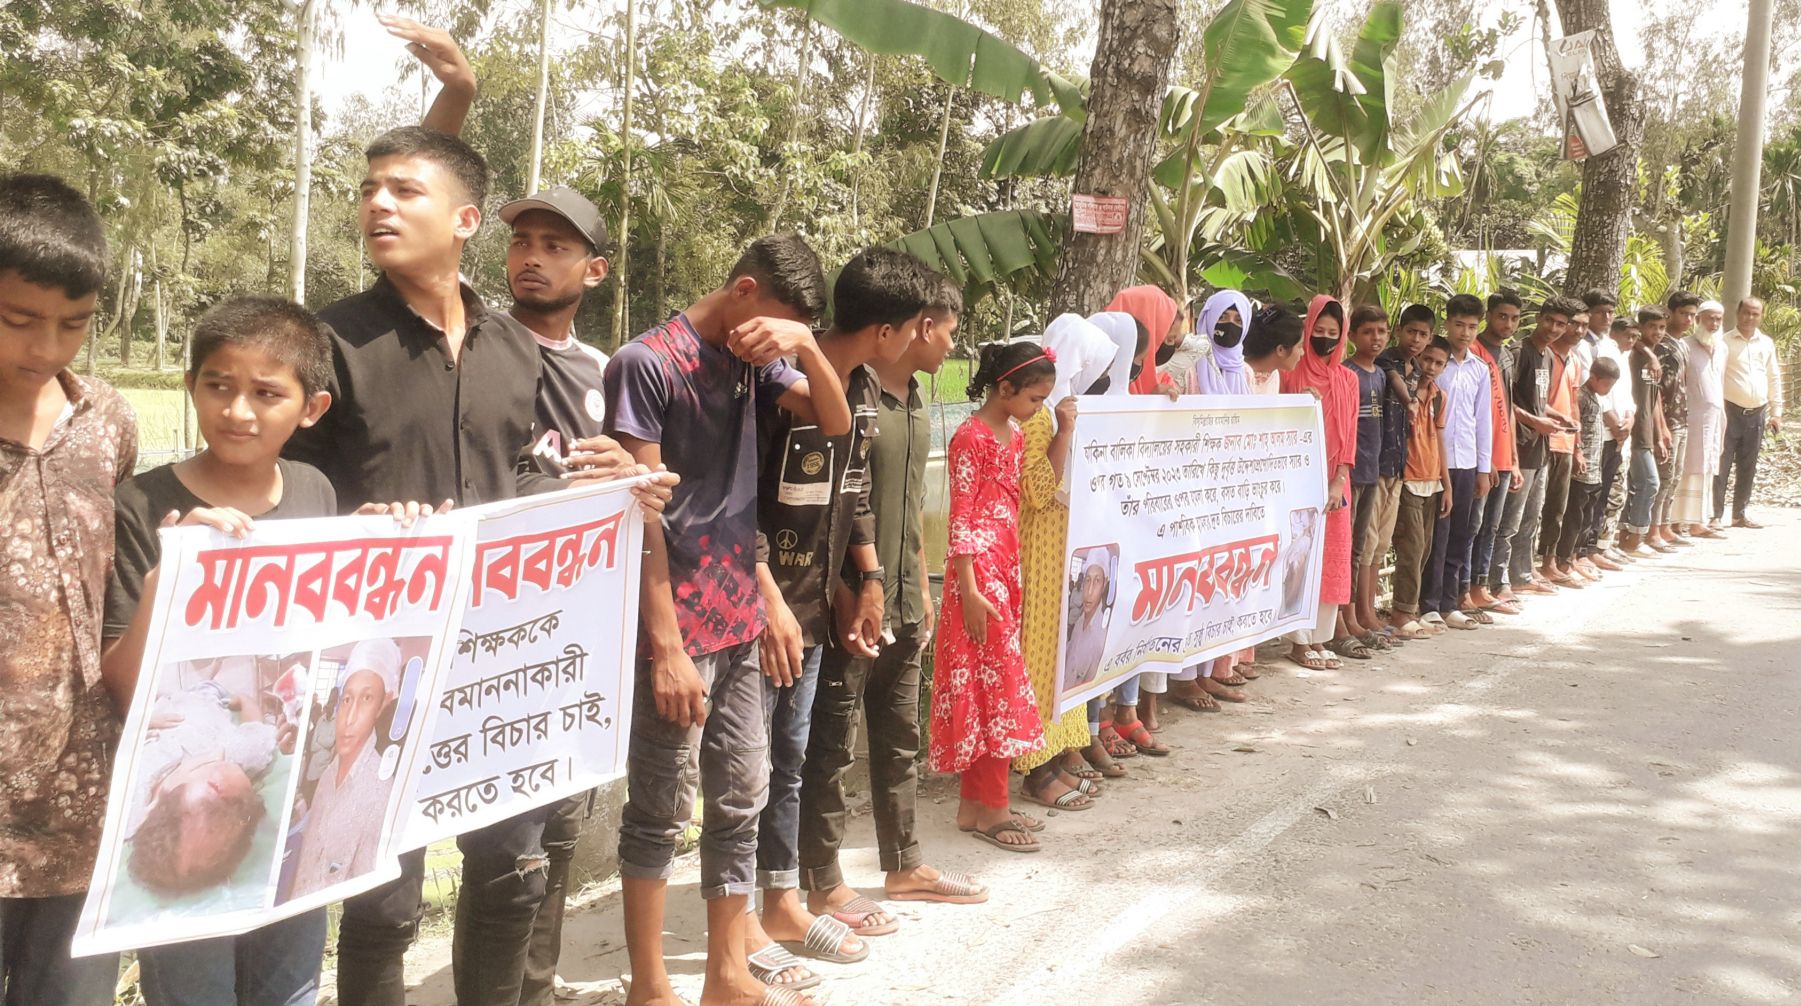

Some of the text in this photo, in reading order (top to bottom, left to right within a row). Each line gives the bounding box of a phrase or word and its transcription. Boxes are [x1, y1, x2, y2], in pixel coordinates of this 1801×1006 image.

[1108, 473, 1123, 491] গত
[1120, 495, 1140, 516] তাঁর
[184, 535, 453, 630] মানববন্ধন
[779, 551, 814, 567] WAR
[1131, 534, 1280, 623] মানববন্ধন
[479, 715, 552, 757] বিচার
[559, 691, 612, 730] চাই,
[417, 775, 501, 824] করতে
